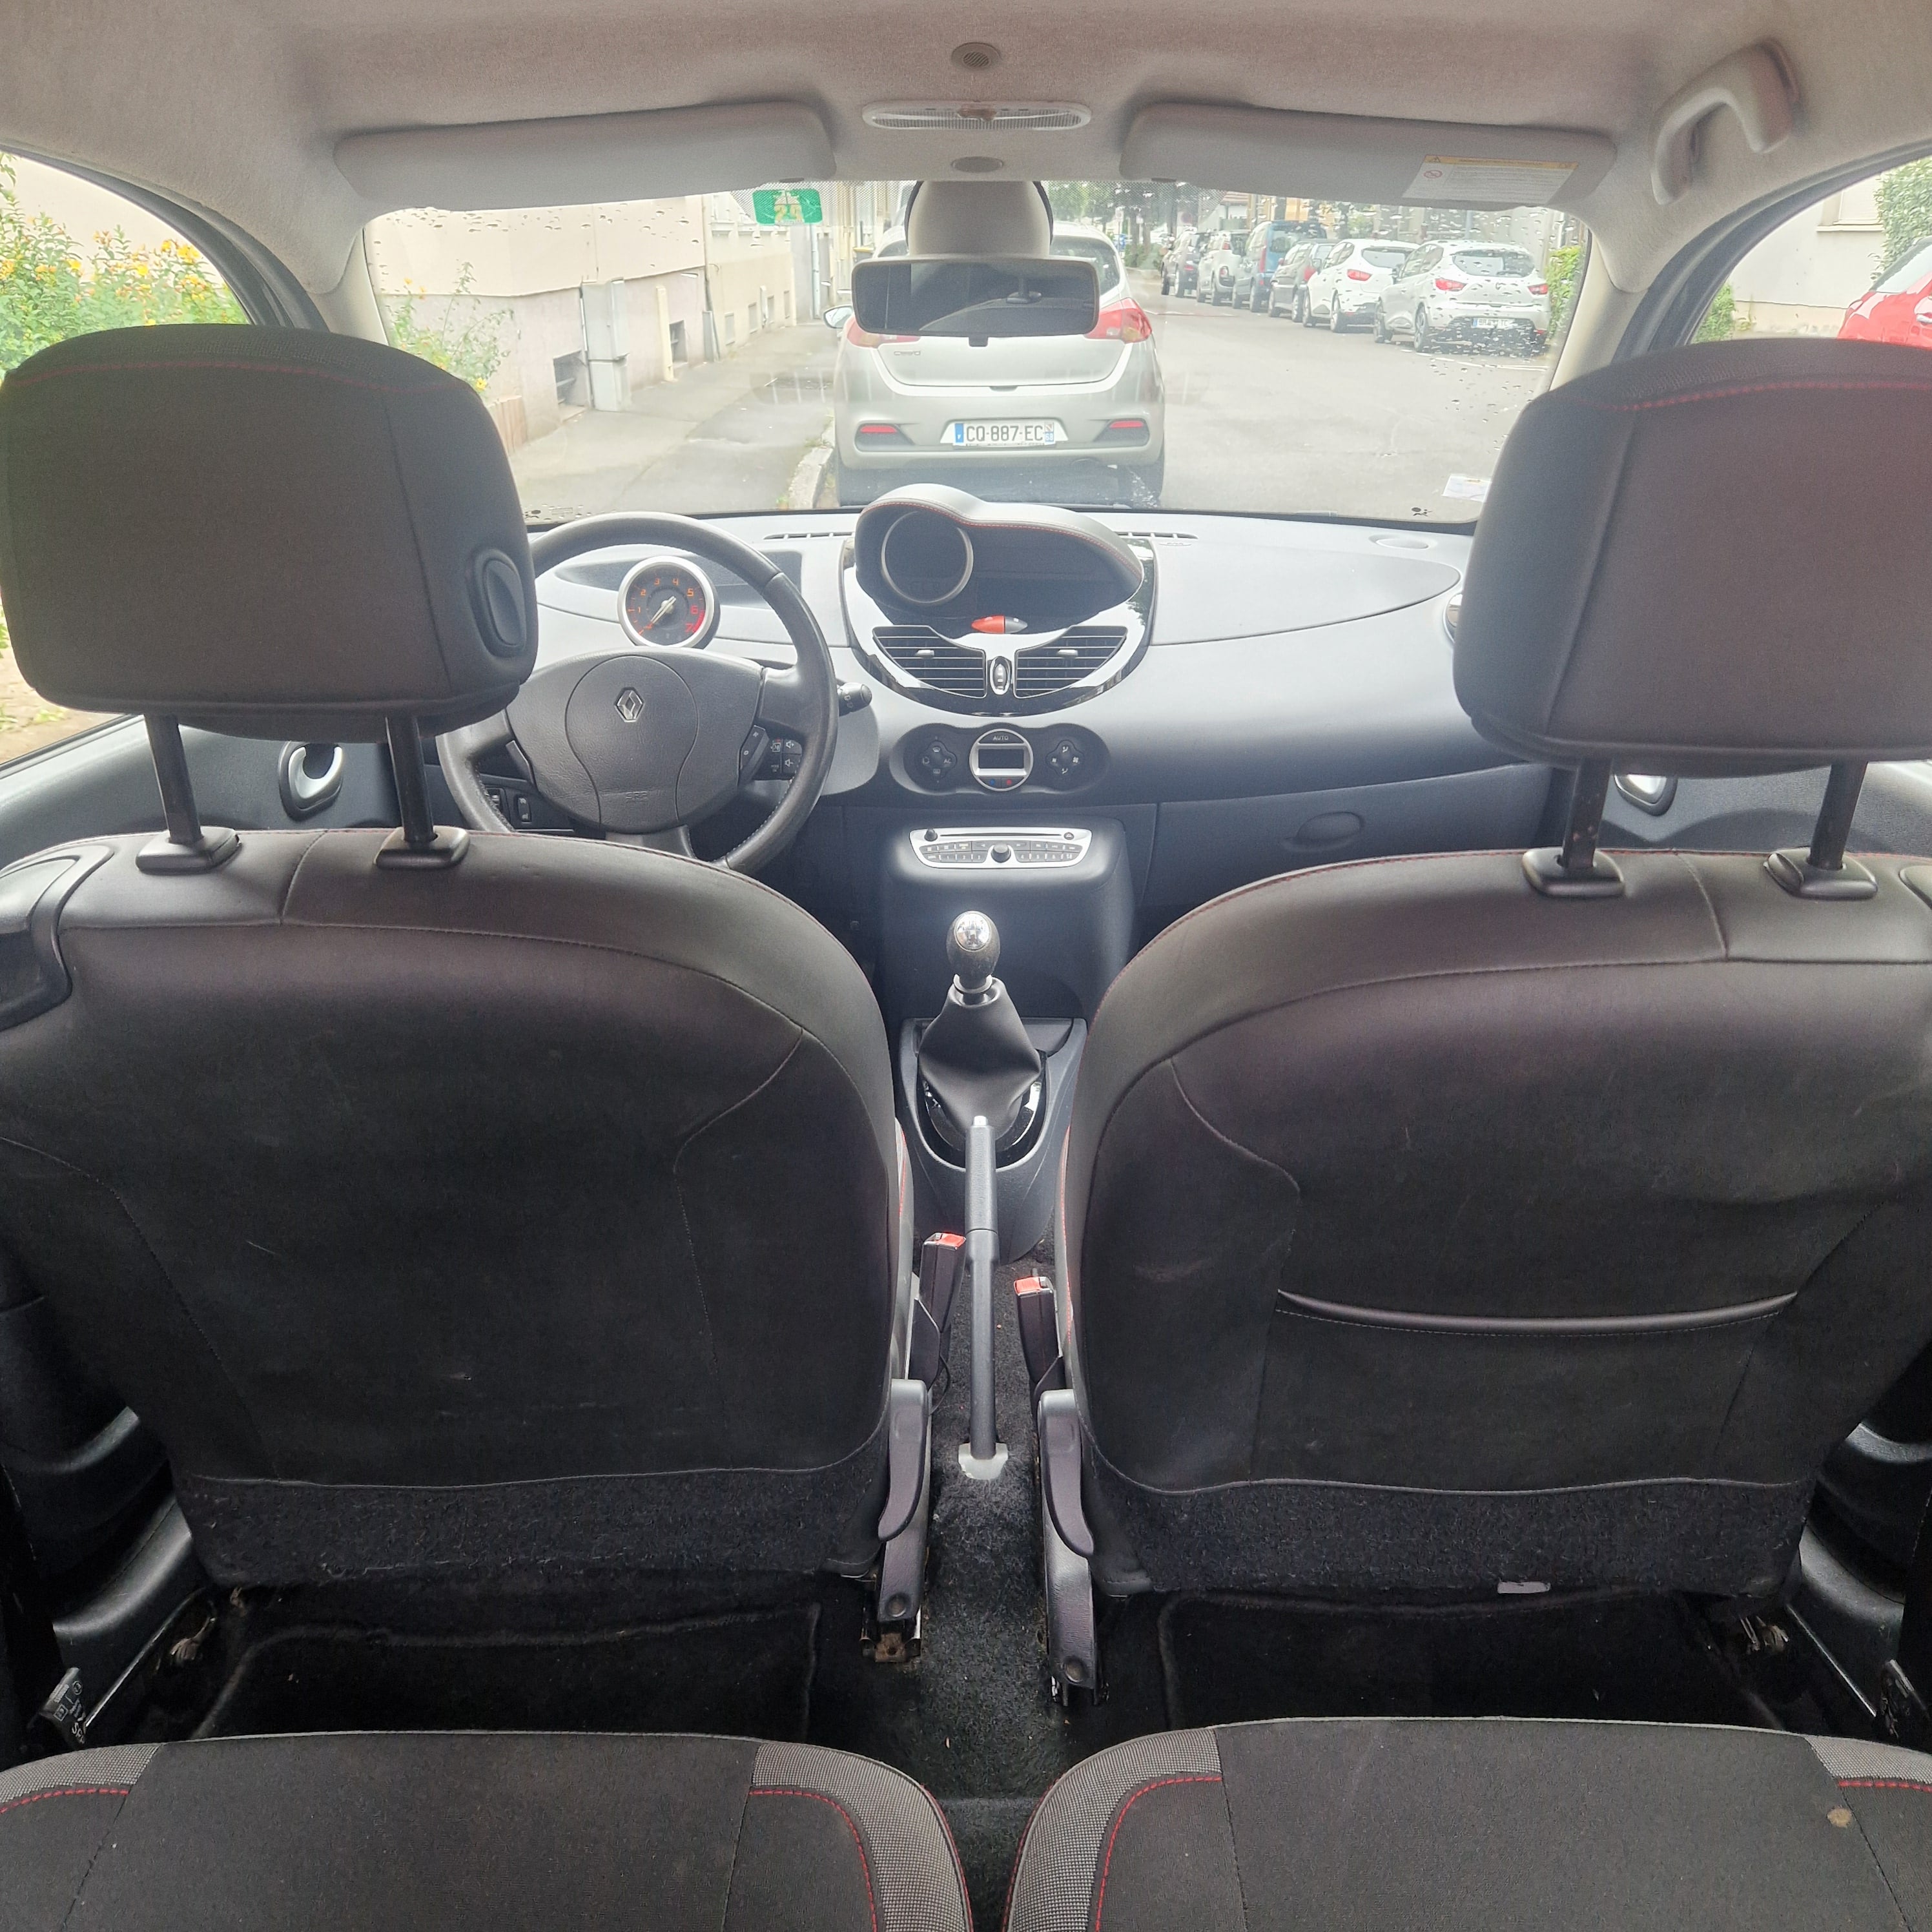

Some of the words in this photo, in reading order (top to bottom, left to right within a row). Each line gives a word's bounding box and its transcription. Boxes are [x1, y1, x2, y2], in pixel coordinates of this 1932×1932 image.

[966, 425, 1043, 442] CQ-887-EC
[1045, 432, 1054, 441] 68
[672, 578, 679, 586] 4
[687, 588, 694, 597] 5
[690, 605, 699, 615] 6
[685, 623, 694, 632] 7
